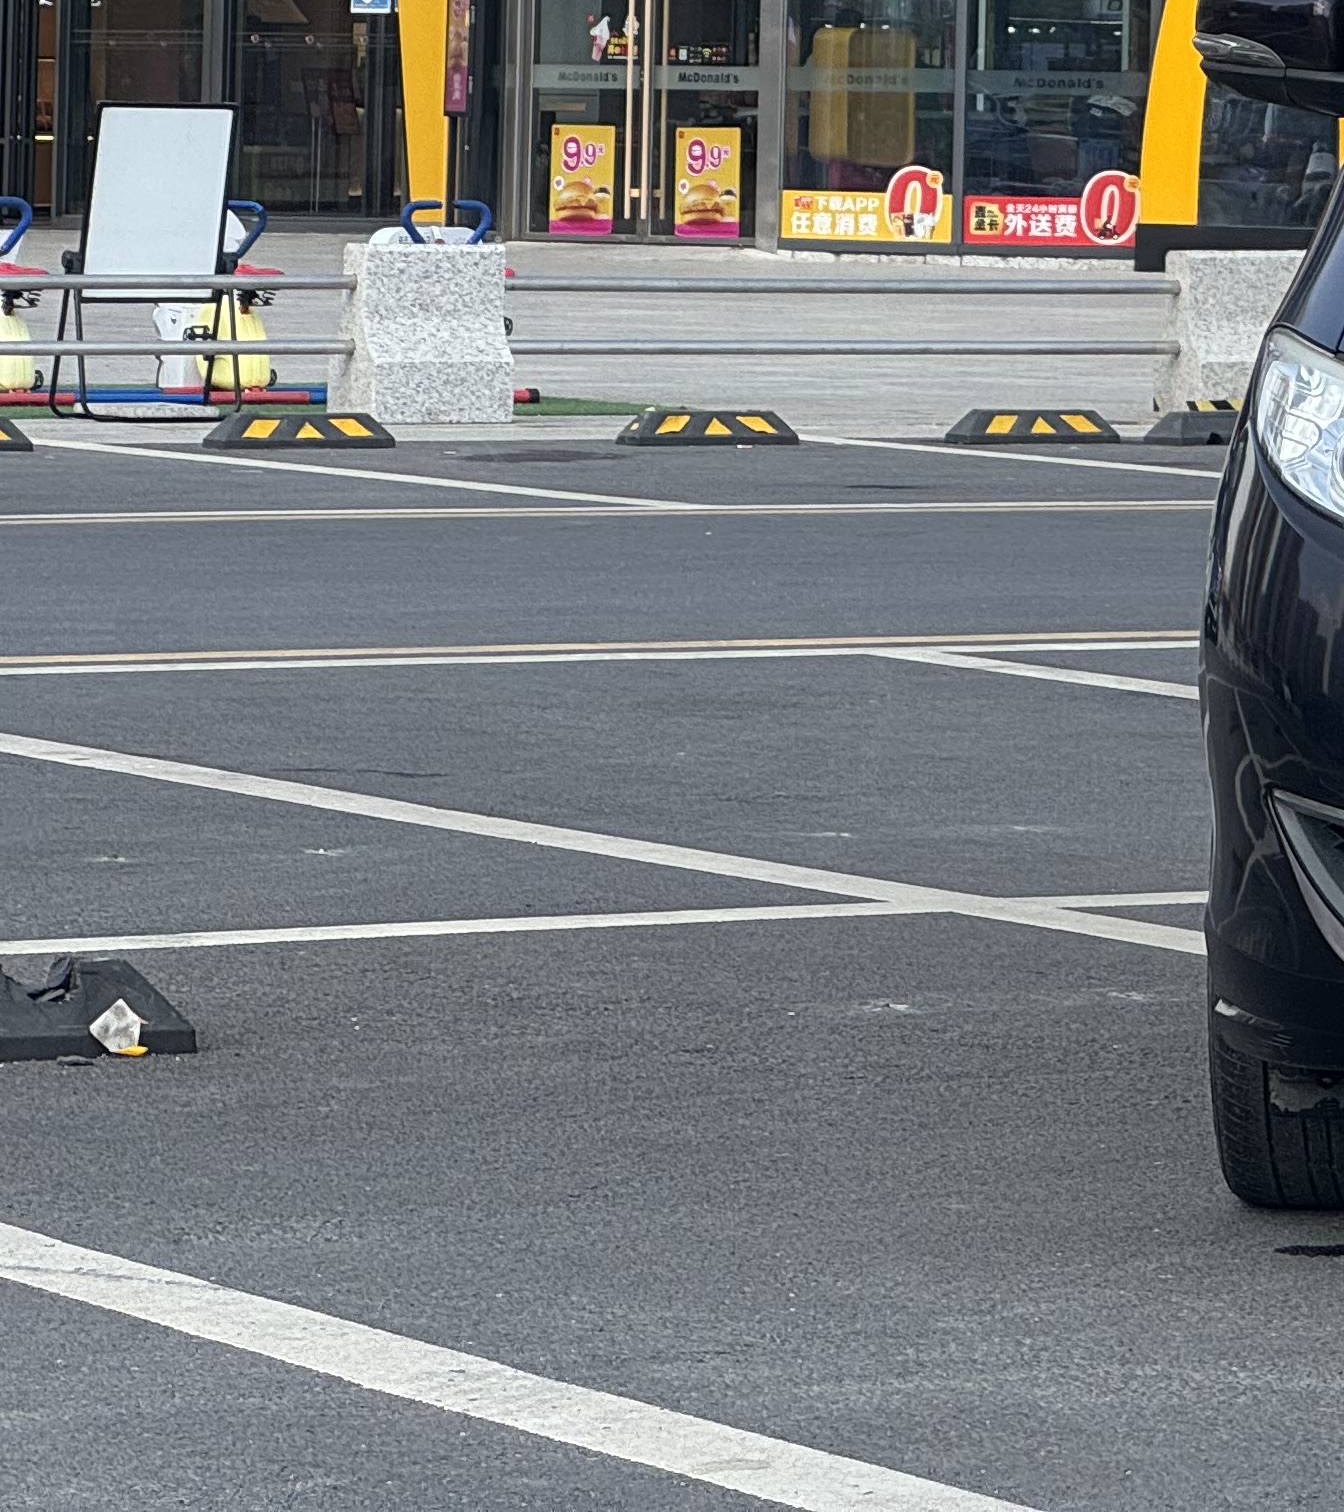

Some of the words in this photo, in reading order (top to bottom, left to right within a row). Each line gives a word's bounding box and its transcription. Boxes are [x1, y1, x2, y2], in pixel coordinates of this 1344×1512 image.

[558, 71, 618, 83] McDonald's
[678, 72, 739, 85] McDonald's
[825, 73, 909, 86] cDonald's
[1014, 76, 1104, 90] McDonald's
[791, 213, 878, 237] 任意消费
[1003, 214, 1078, 238] 外送费
